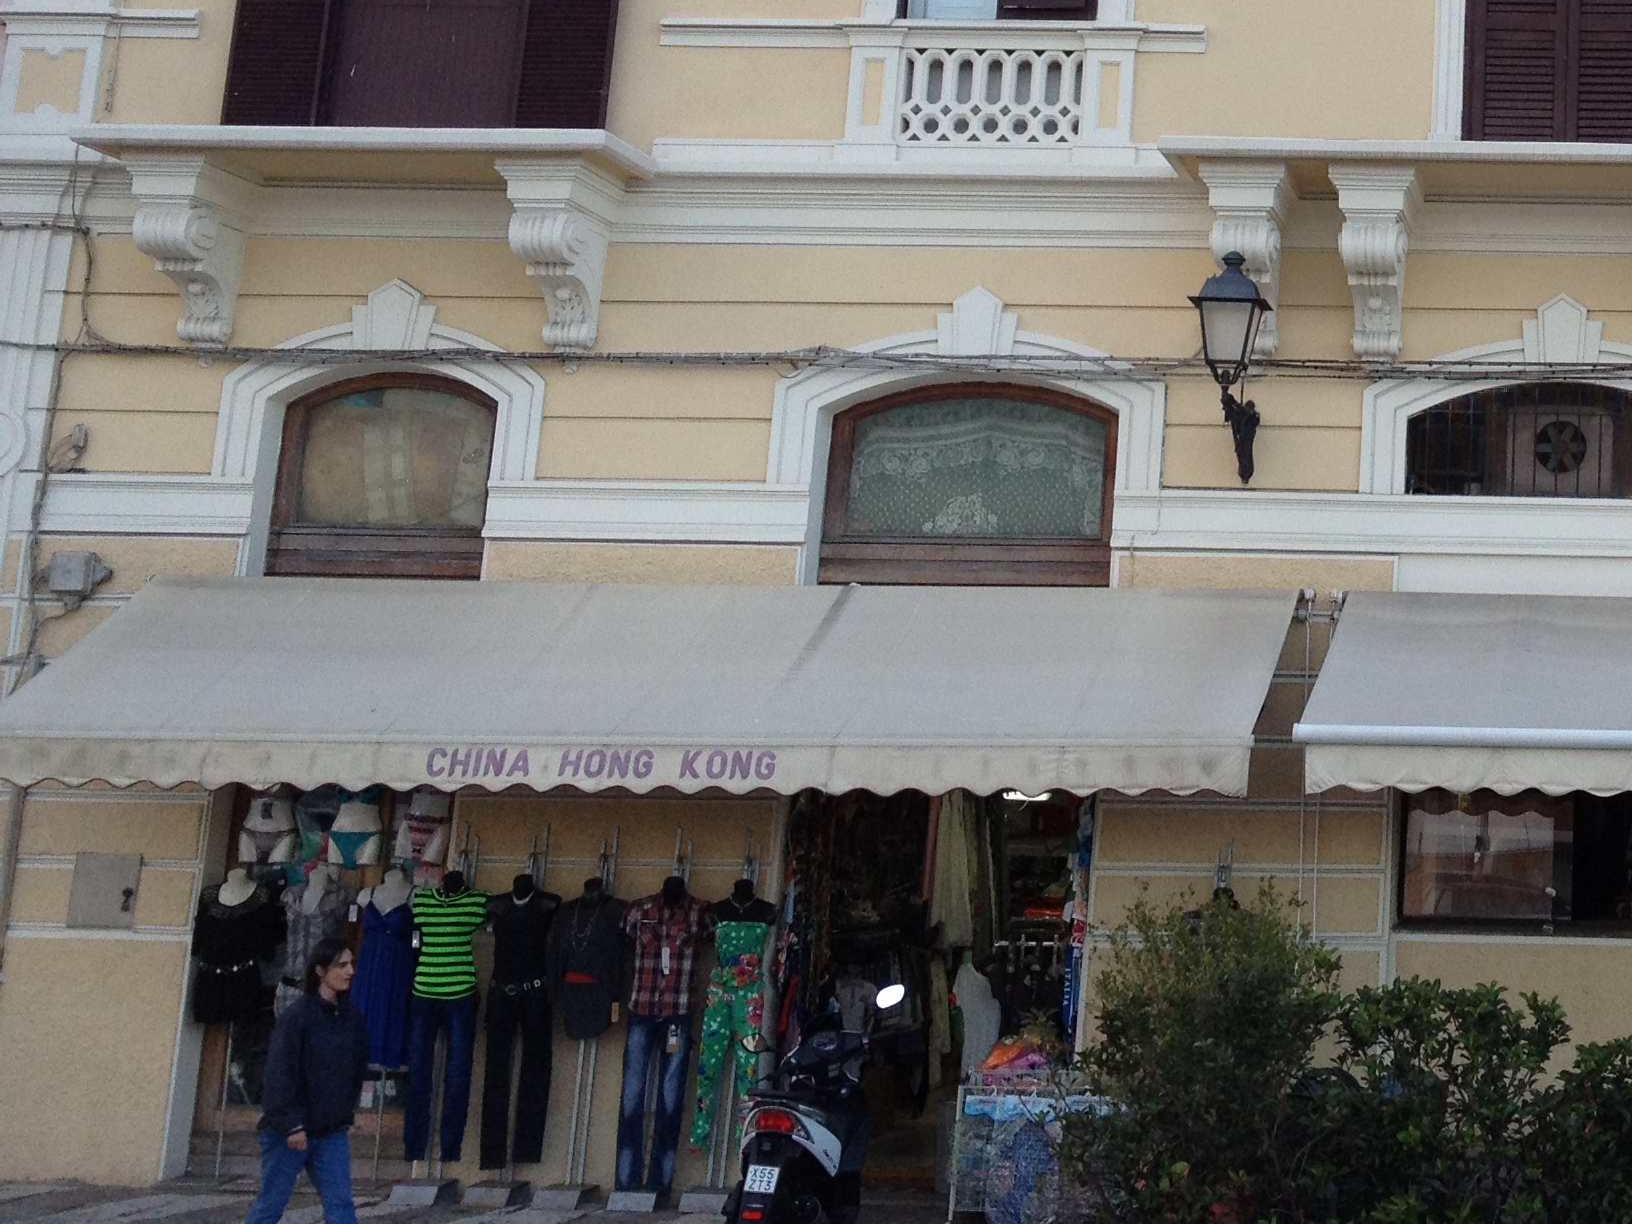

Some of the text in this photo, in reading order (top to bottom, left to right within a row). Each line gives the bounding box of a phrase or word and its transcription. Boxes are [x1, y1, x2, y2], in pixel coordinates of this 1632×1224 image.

[426, 747, 777, 781] CHINA HONG KONG
[748, 1179, 772, 1191] ZT3
